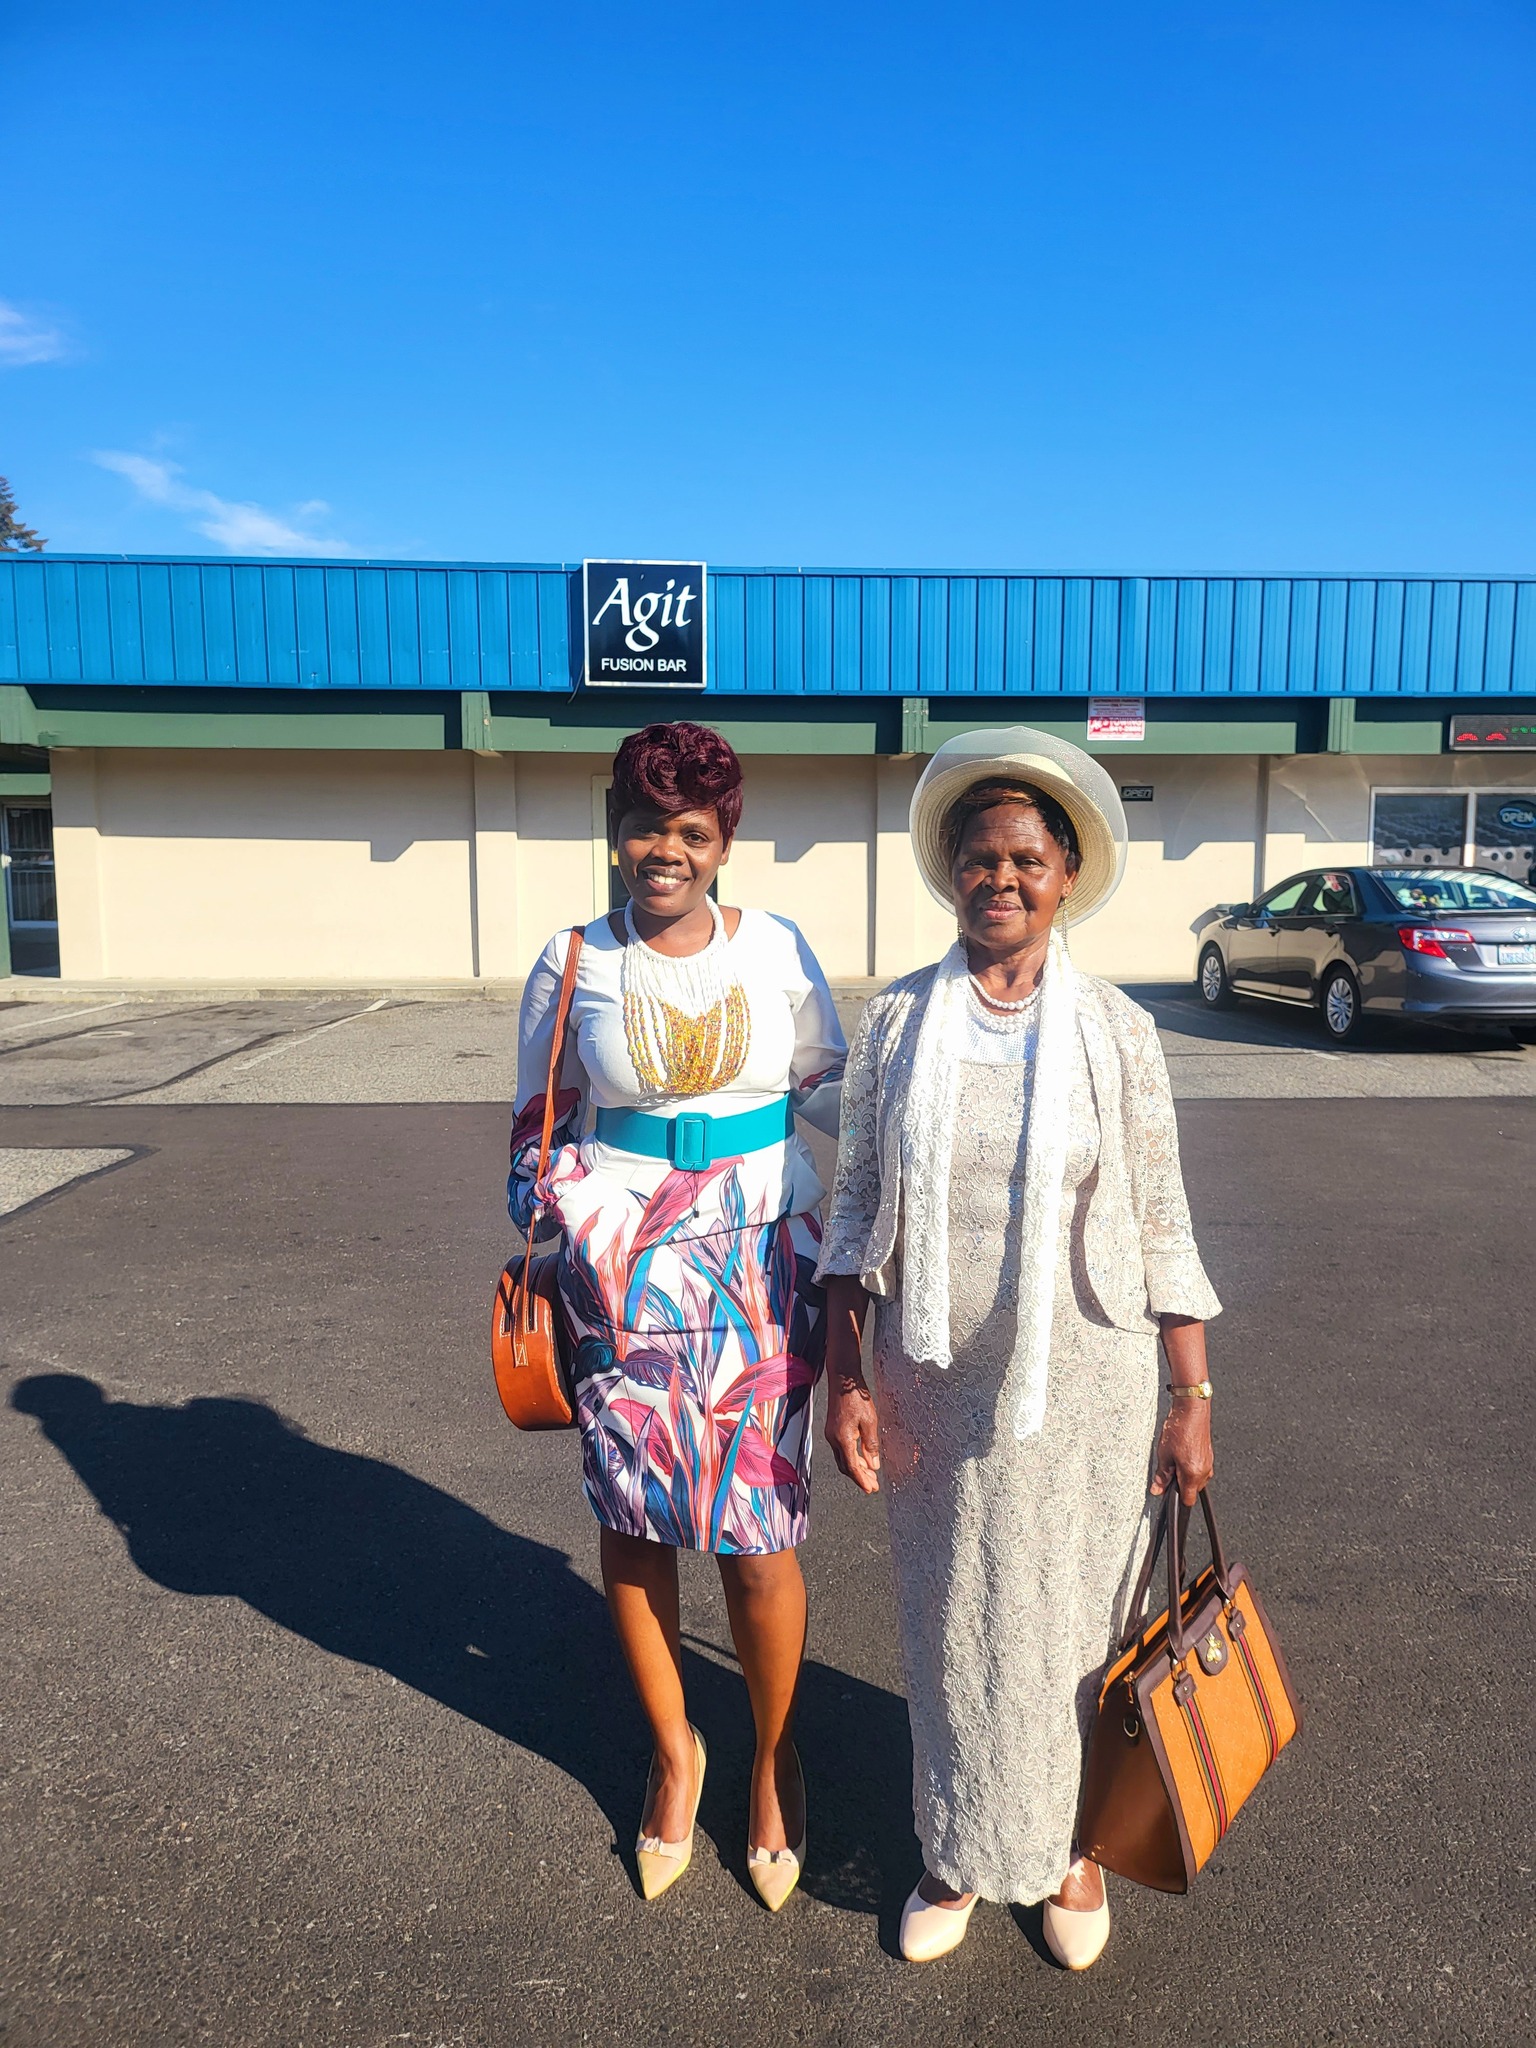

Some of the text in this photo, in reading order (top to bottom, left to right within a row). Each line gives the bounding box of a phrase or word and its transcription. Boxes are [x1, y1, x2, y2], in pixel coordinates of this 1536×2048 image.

[592, 577, 697, 652] Agit
[601, 658, 687, 672] FUSION BAR
[1123, 788, 1152, 798] OPEN
[1502, 811, 1533, 823] OPEN
